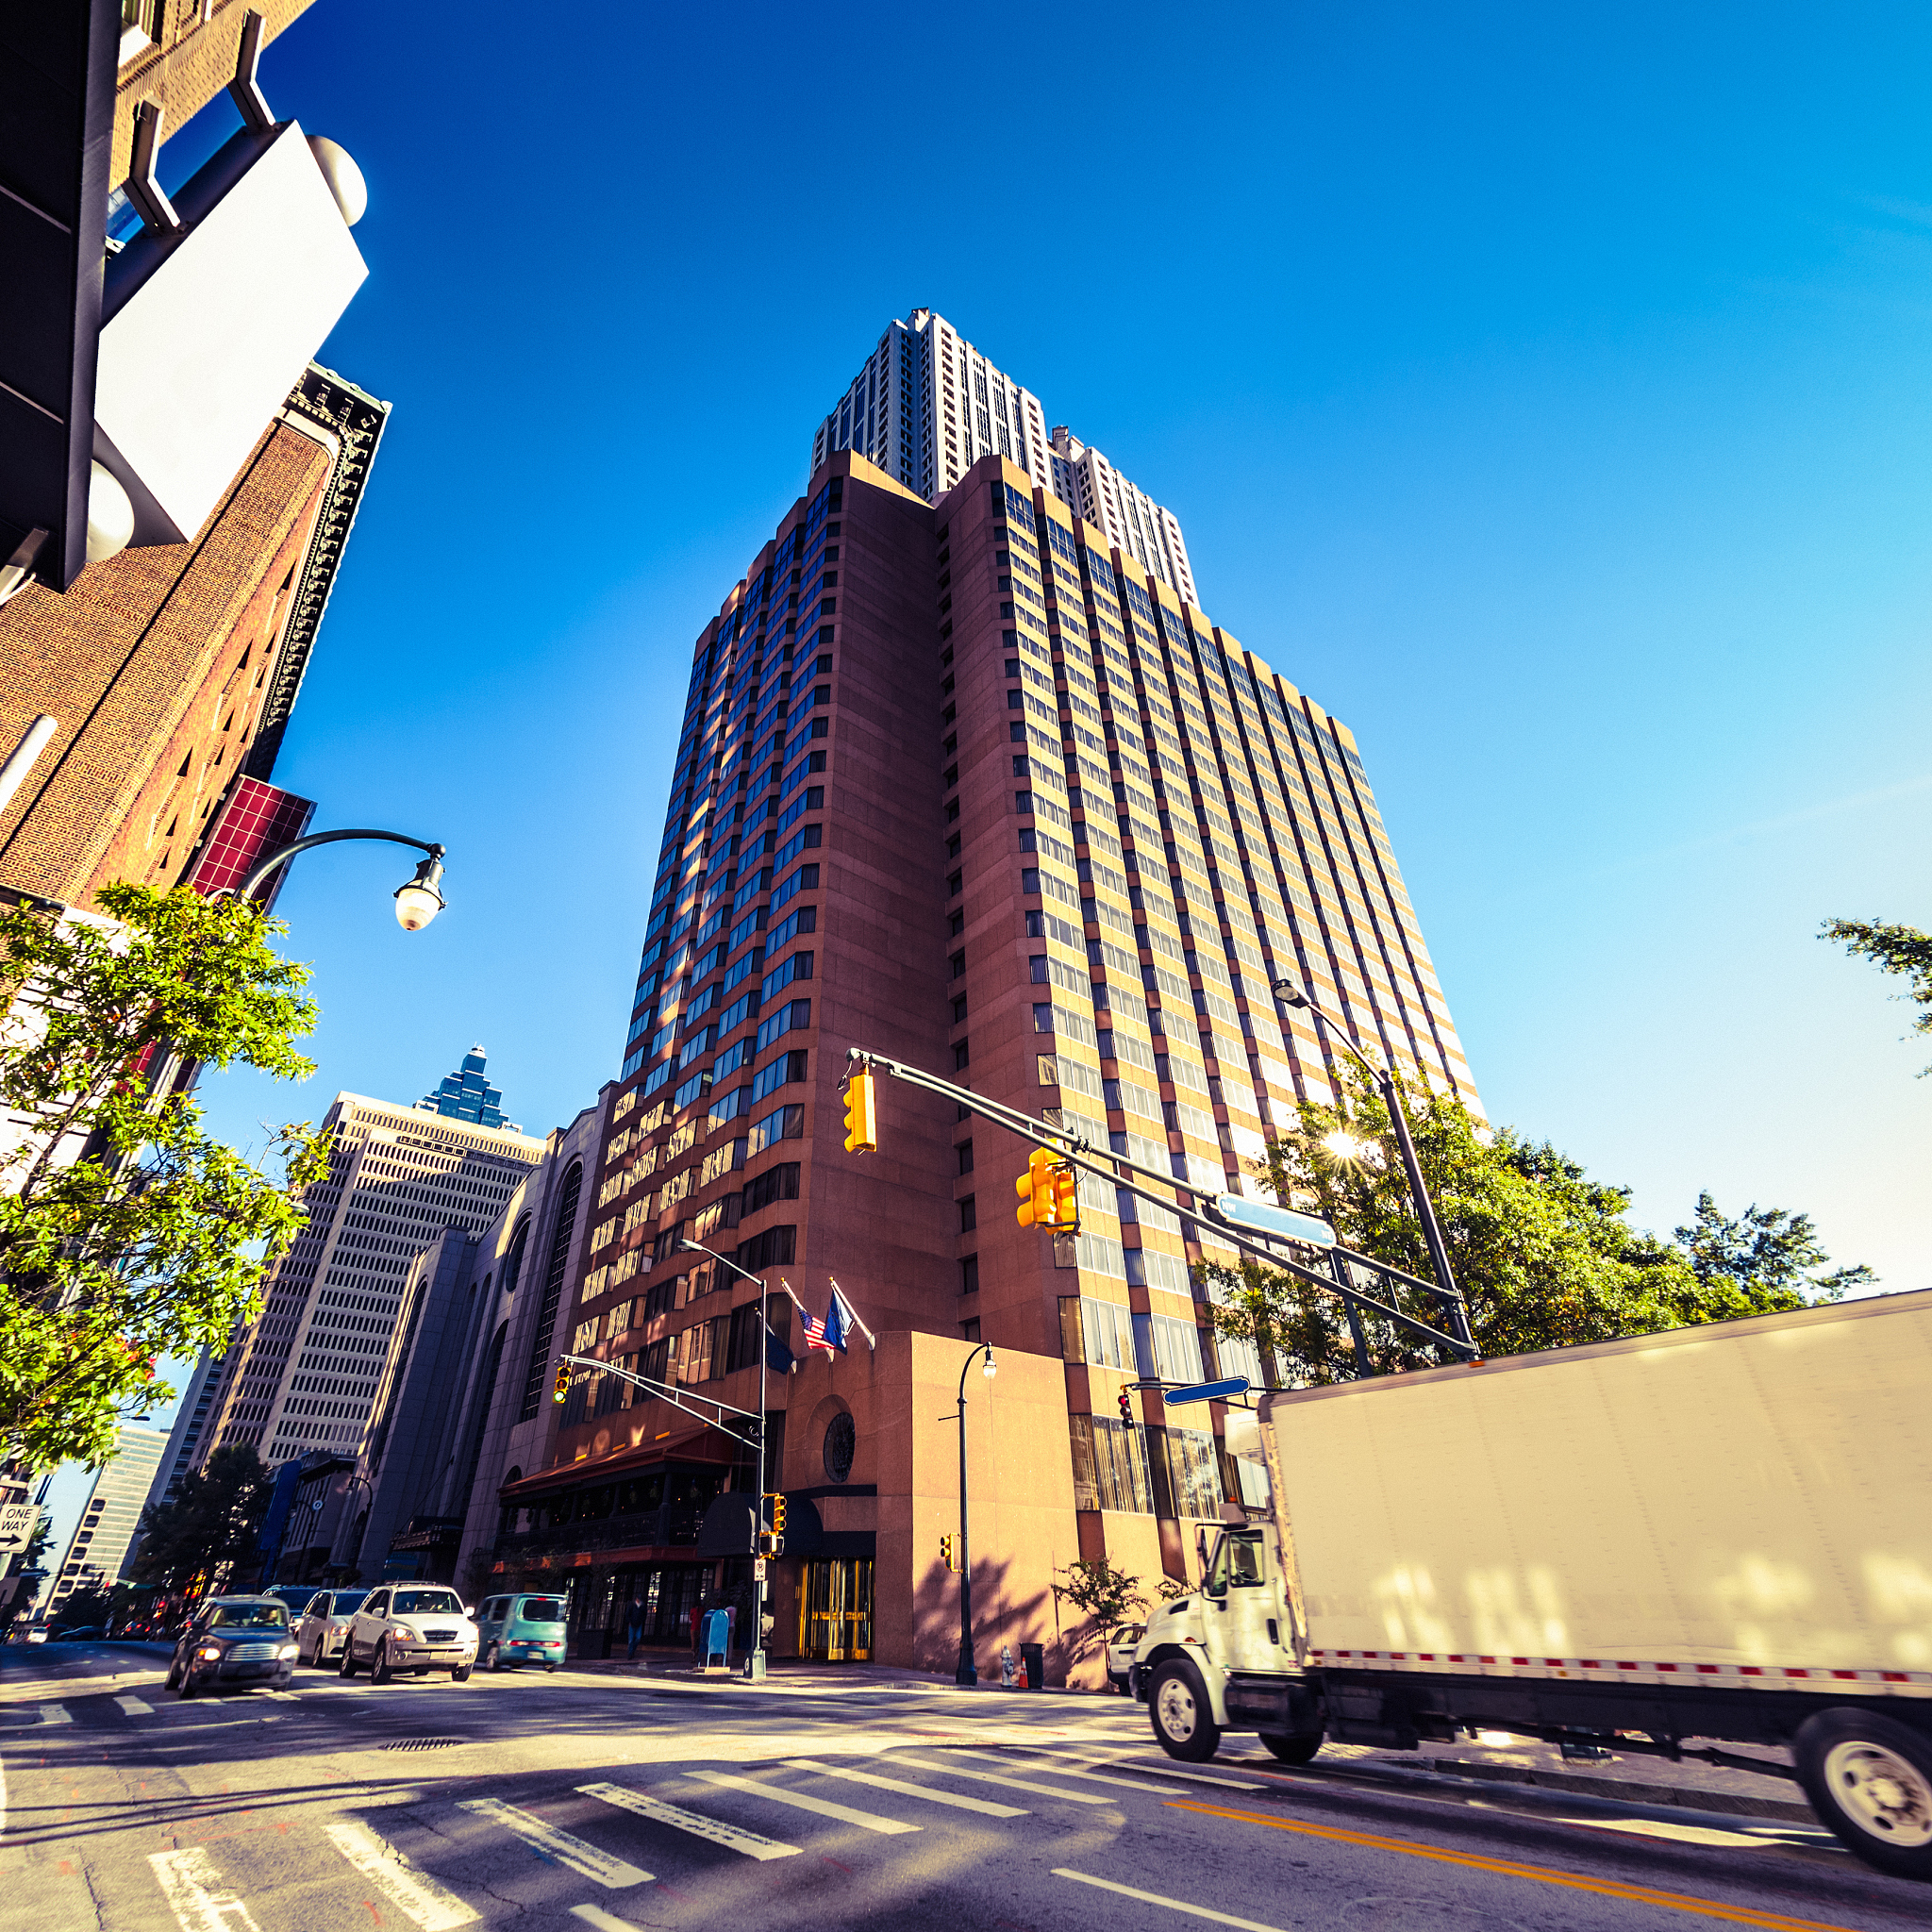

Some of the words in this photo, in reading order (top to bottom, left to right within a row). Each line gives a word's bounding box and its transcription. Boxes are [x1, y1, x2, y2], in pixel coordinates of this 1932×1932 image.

[1222, 1200, 1236, 1213] NW
[6, 1508, 33, 1519] ONE
[1, 1521, 29, 1531] WAY
